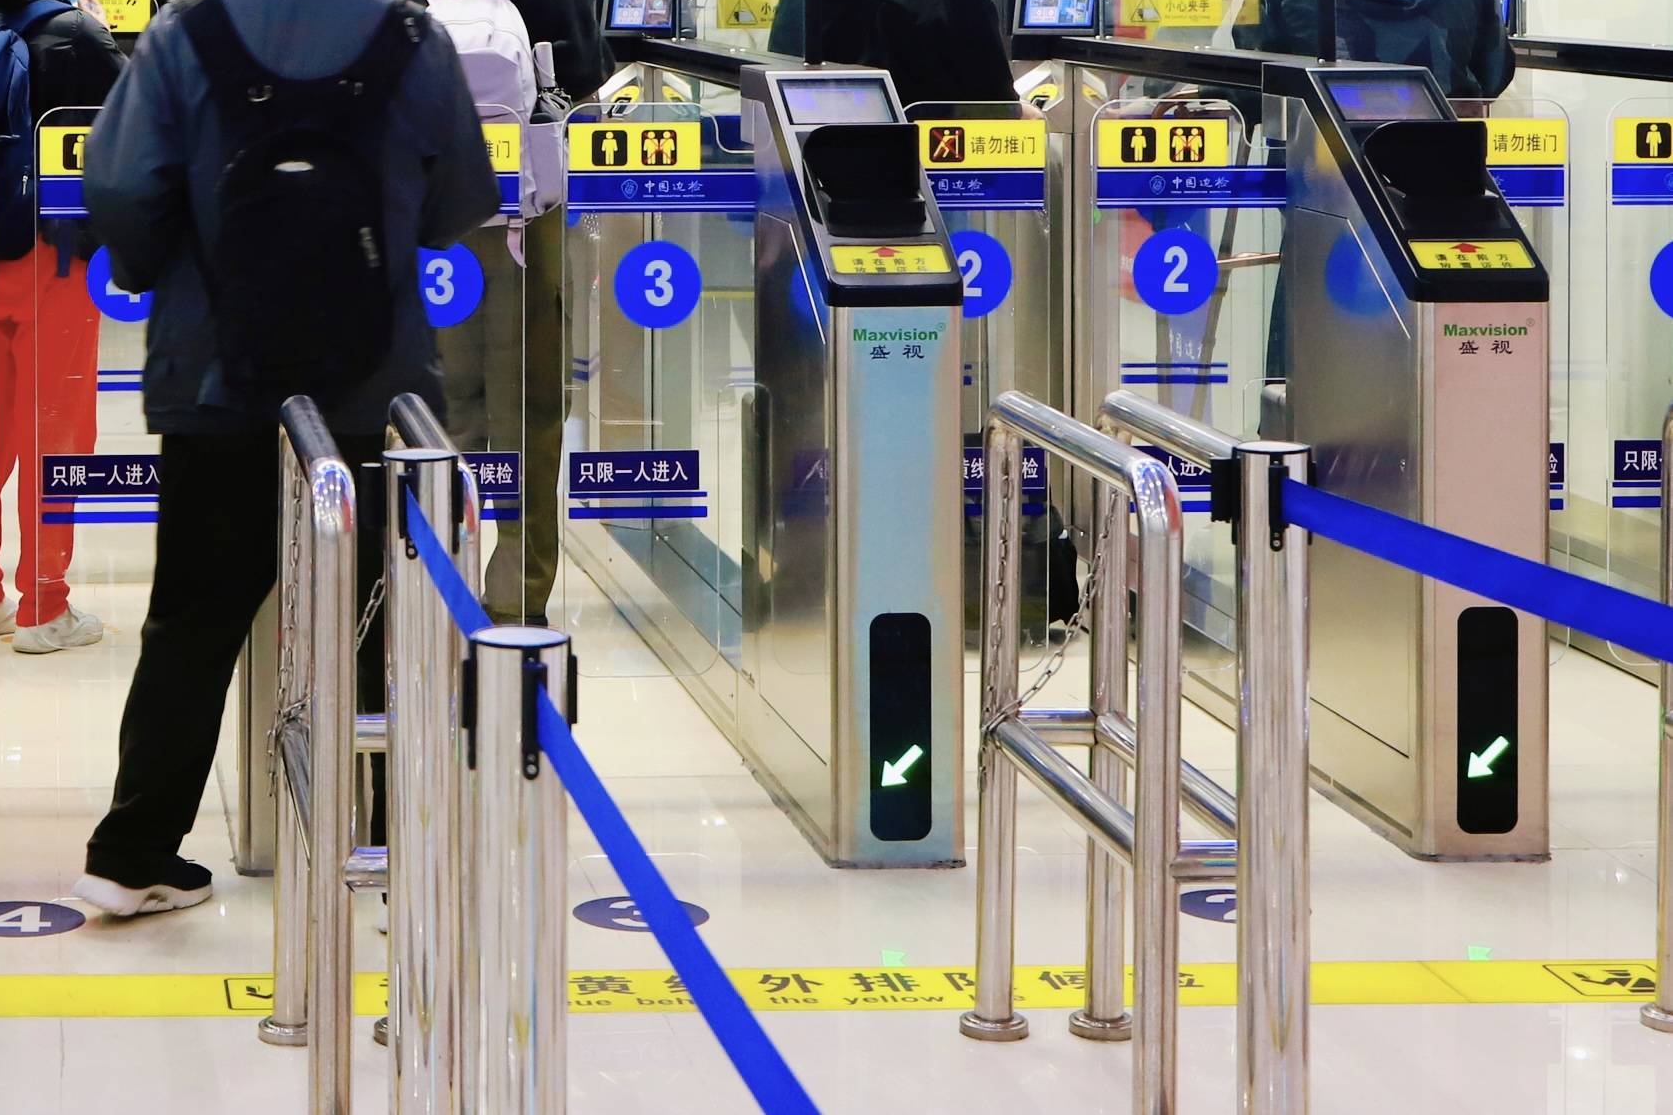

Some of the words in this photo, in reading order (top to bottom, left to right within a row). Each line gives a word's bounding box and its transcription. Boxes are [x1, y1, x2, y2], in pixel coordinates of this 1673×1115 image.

[1165, 0, 1210, 13] 小心夹手
[970, 135, 1036, 155] 请勿推门
[1493, 133, 1558, 153] 请勿推门
[957, 249, 983, 297] 2
[1163, 245, 1189, 293] 2
[425, 258, 455, 305] 3
[645, 259, 674, 307] 3
[852, 328, 939, 342] Maxvision
[1443, 323, 1529, 337] Maxvision
[869, 344, 925, 360] 盛视
[1458, 339, 1514, 355] 盛视
[51, 464, 161, 487] 只限一人进入
[578, 460, 689, 484] 只限一人进入
[769, 995, 819, 1005] the
[843, 995, 945, 1007] yellow
